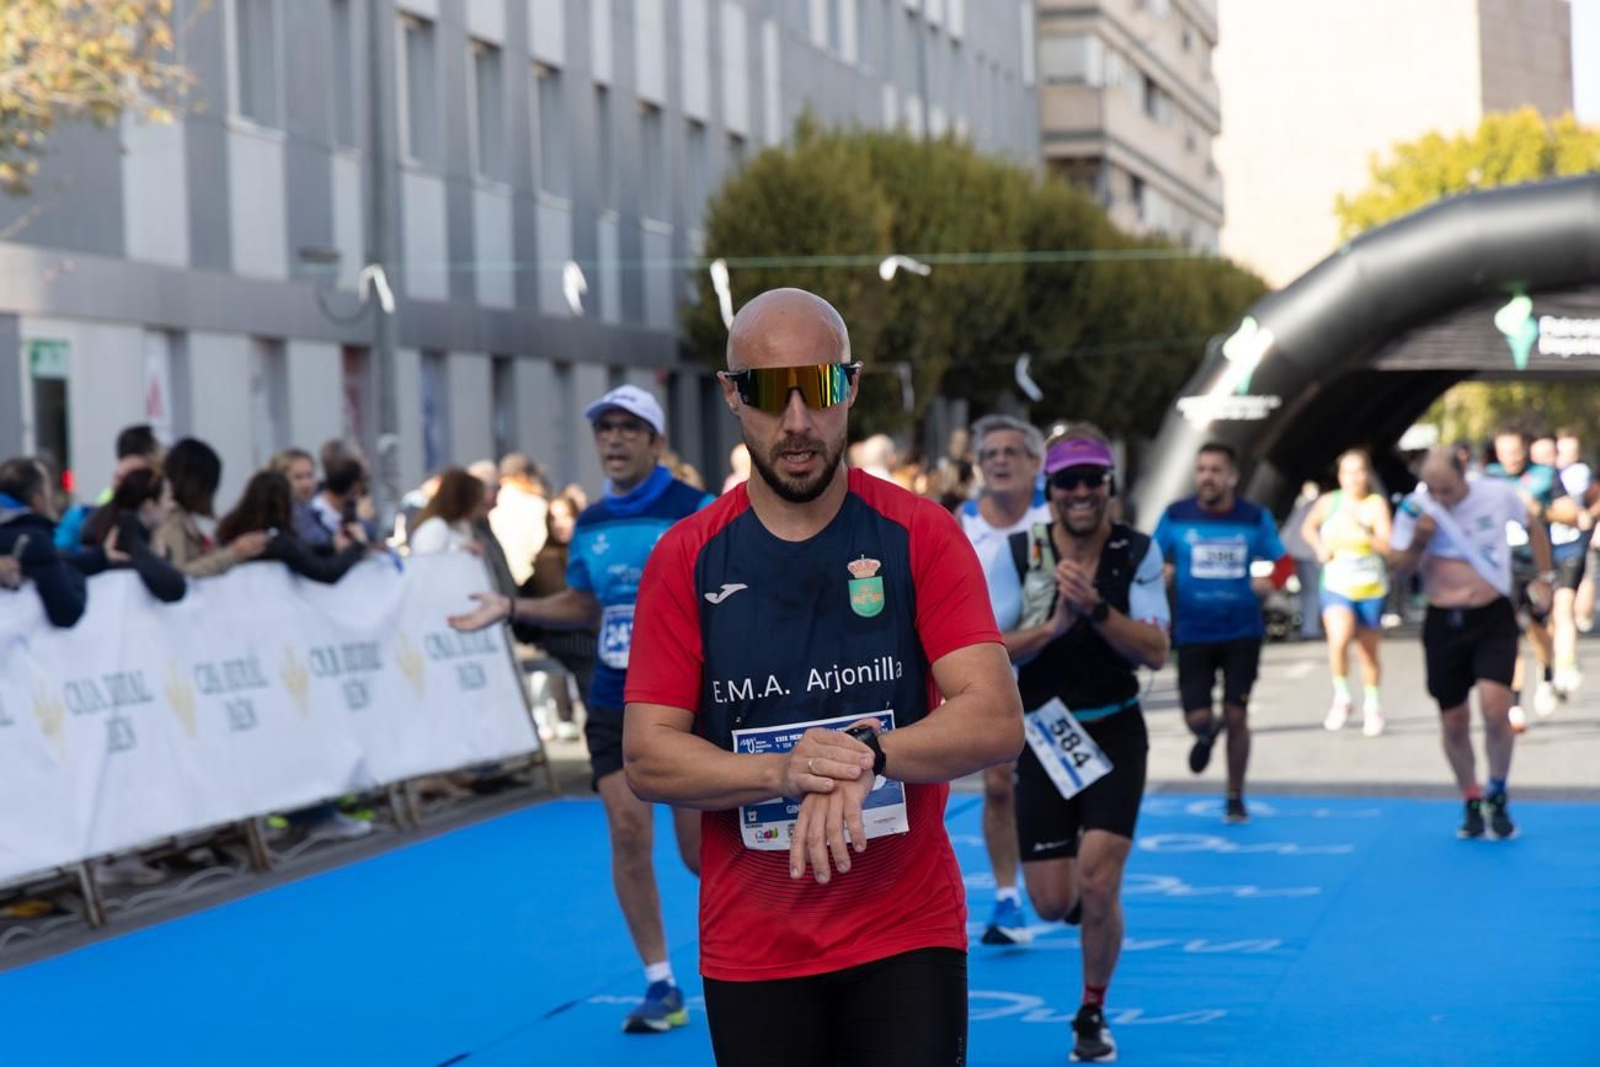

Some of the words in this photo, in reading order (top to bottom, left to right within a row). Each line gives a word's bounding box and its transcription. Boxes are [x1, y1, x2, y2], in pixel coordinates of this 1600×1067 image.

[713, 675, 791, 703] E.M.A.
[806, 656, 902, 693] Arjonilla
[1050, 718, 1091, 768] 584
